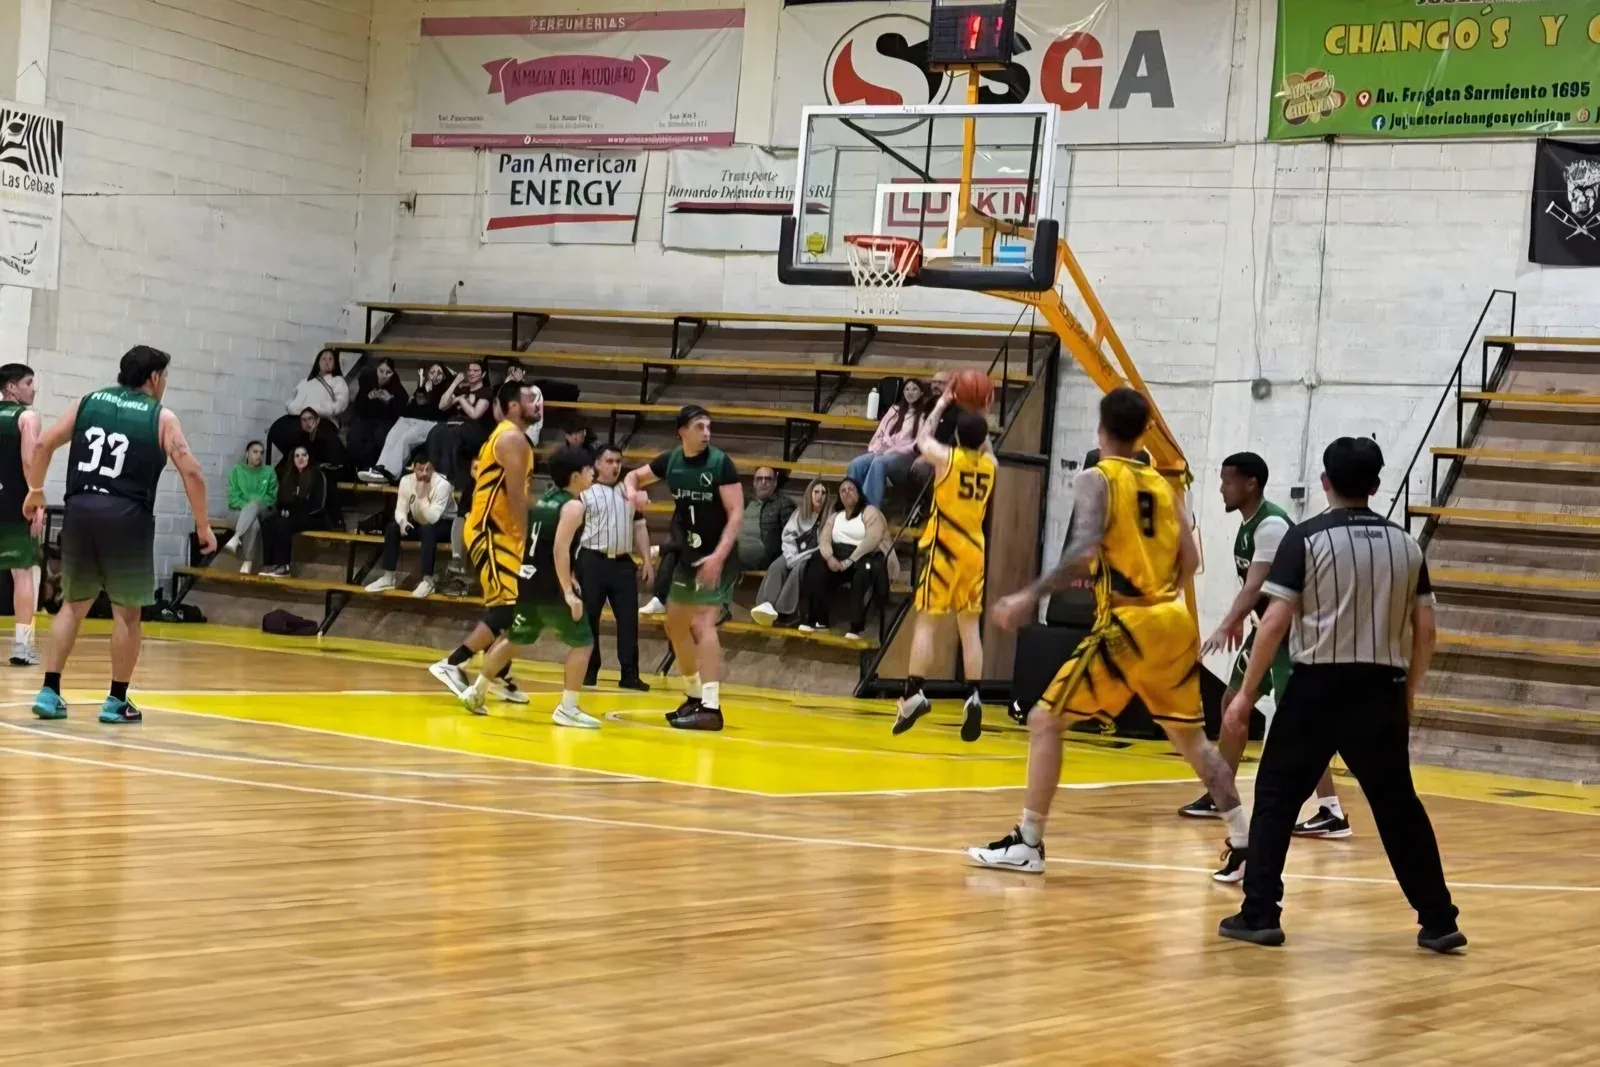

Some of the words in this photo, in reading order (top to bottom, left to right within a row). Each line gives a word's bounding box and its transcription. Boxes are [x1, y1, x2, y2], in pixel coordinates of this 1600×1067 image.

[529, 17, 626, 30] PERFUMERIAS
[1539, 15, 1568, 46] Y
[1376, 88, 1398, 103] Av.
[1402, 86, 1460, 107] Fragata
[1464, 83, 1547, 101] Sarmiento
[1551, 81, 1590, 98] 1695
[499, 153, 536, 174] Pan
[538, 152, 637, 174] American
[2, 169, 20, 189] Las
[23, 175, 55, 195] Cebas
[510, 179, 623, 207] ENERGY
[902, 191, 1036, 215] LUKIN
[78, 426, 129, 479] 33
[957, 471, 990, 500] 55
